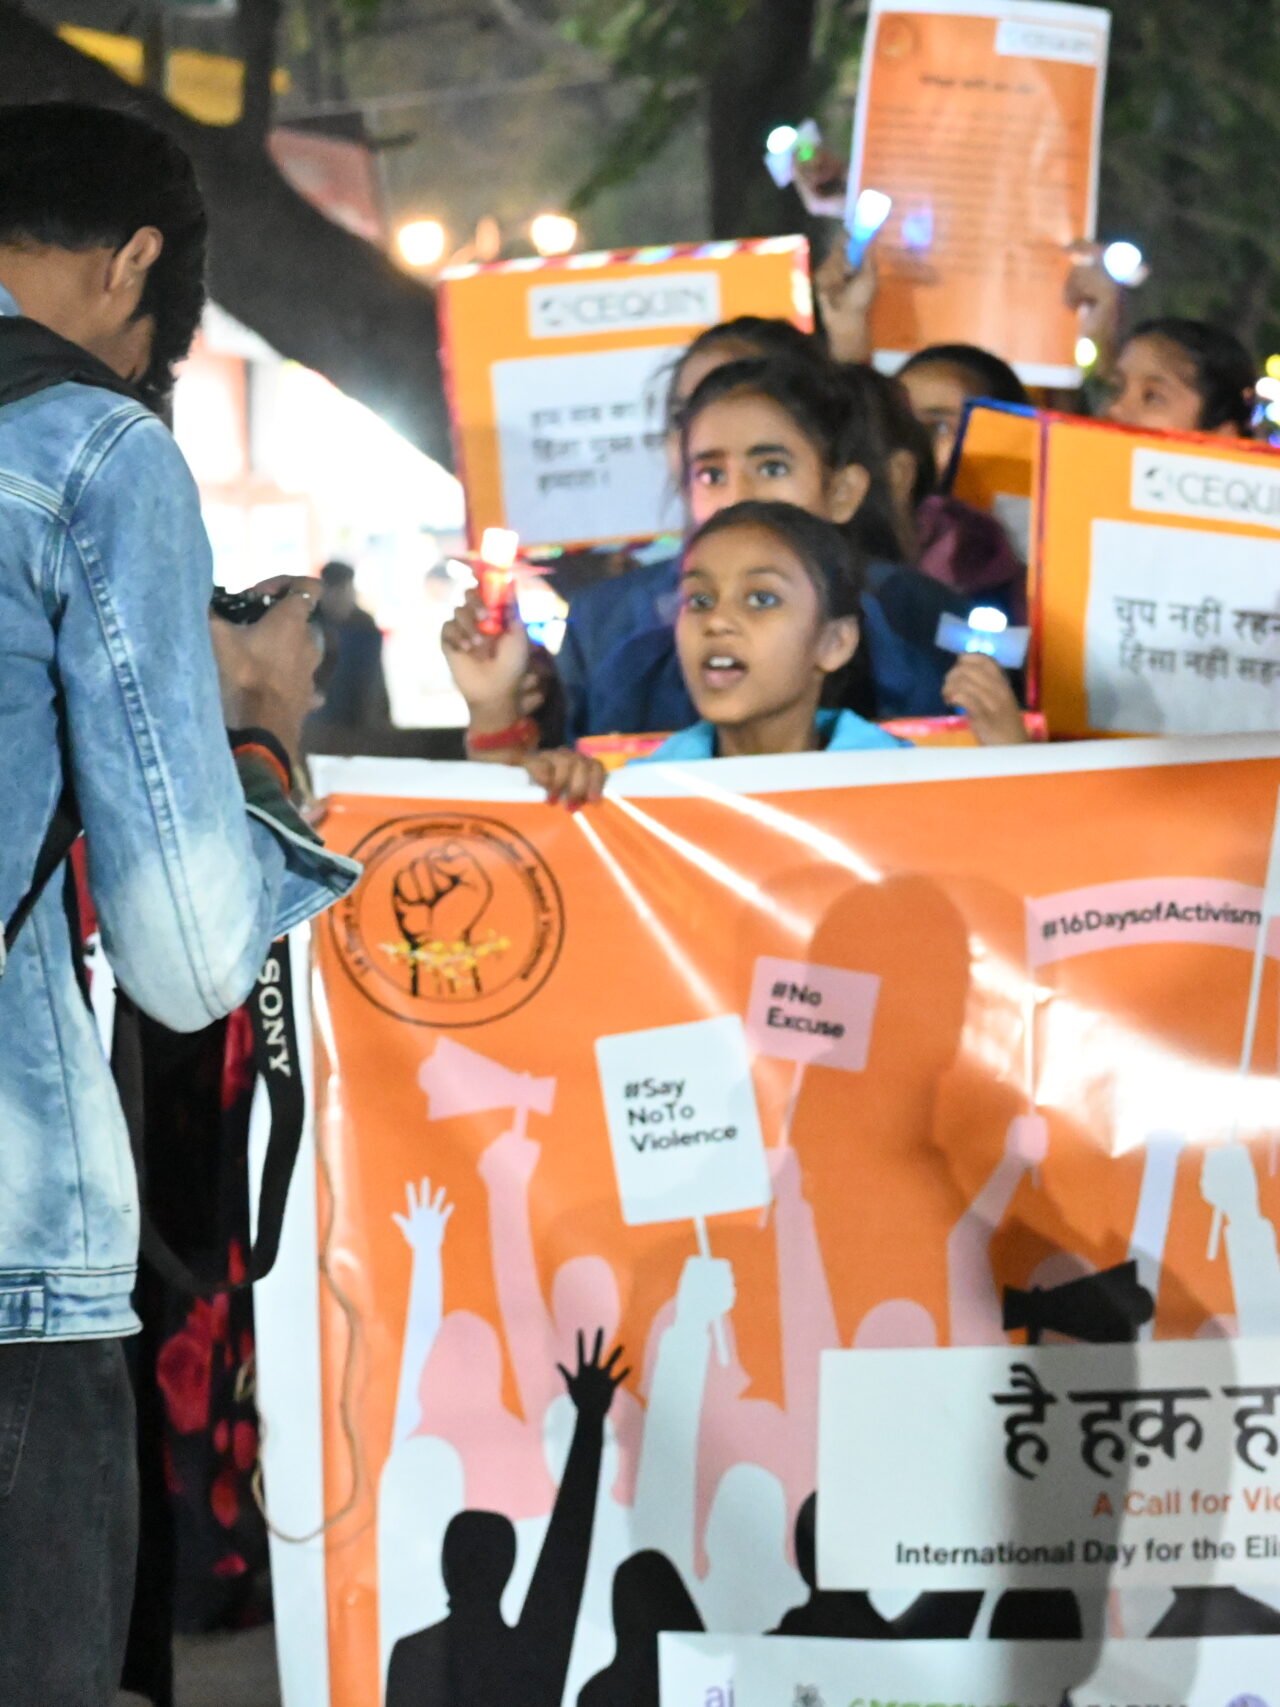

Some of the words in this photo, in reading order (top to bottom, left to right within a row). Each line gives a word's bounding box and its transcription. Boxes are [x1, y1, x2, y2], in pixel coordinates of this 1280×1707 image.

[574, 286, 705, 324] CEQUIN
[1113, 596, 1157, 638] चुप
[1040, 900, 1263, 941] #16DaysofActivism
[771, 980, 823, 1007] #No
[257, 958, 292, 1077] SONY
[765, 1005, 846, 1040] Excuse
[623, 1078, 685, 1104] #Say
[627, 1100, 696, 1127] NoTo
[630, 1124, 739, 1155] Violence
[990, 1360, 1058, 1481] है
[1068, 1387, 1212, 1479] हक़
[1091, 1491, 1115, 1518] A
[1123, 1488, 1182, 1517] Call
[1190, 1486, 1232, 1513] for
[895, 1541, 1075, 1566] International
[1083, 1540, 1137, 1567] Day
[1145, 1537, 1183, 1562] for
[1192, 1535, 1236, 1560] the
